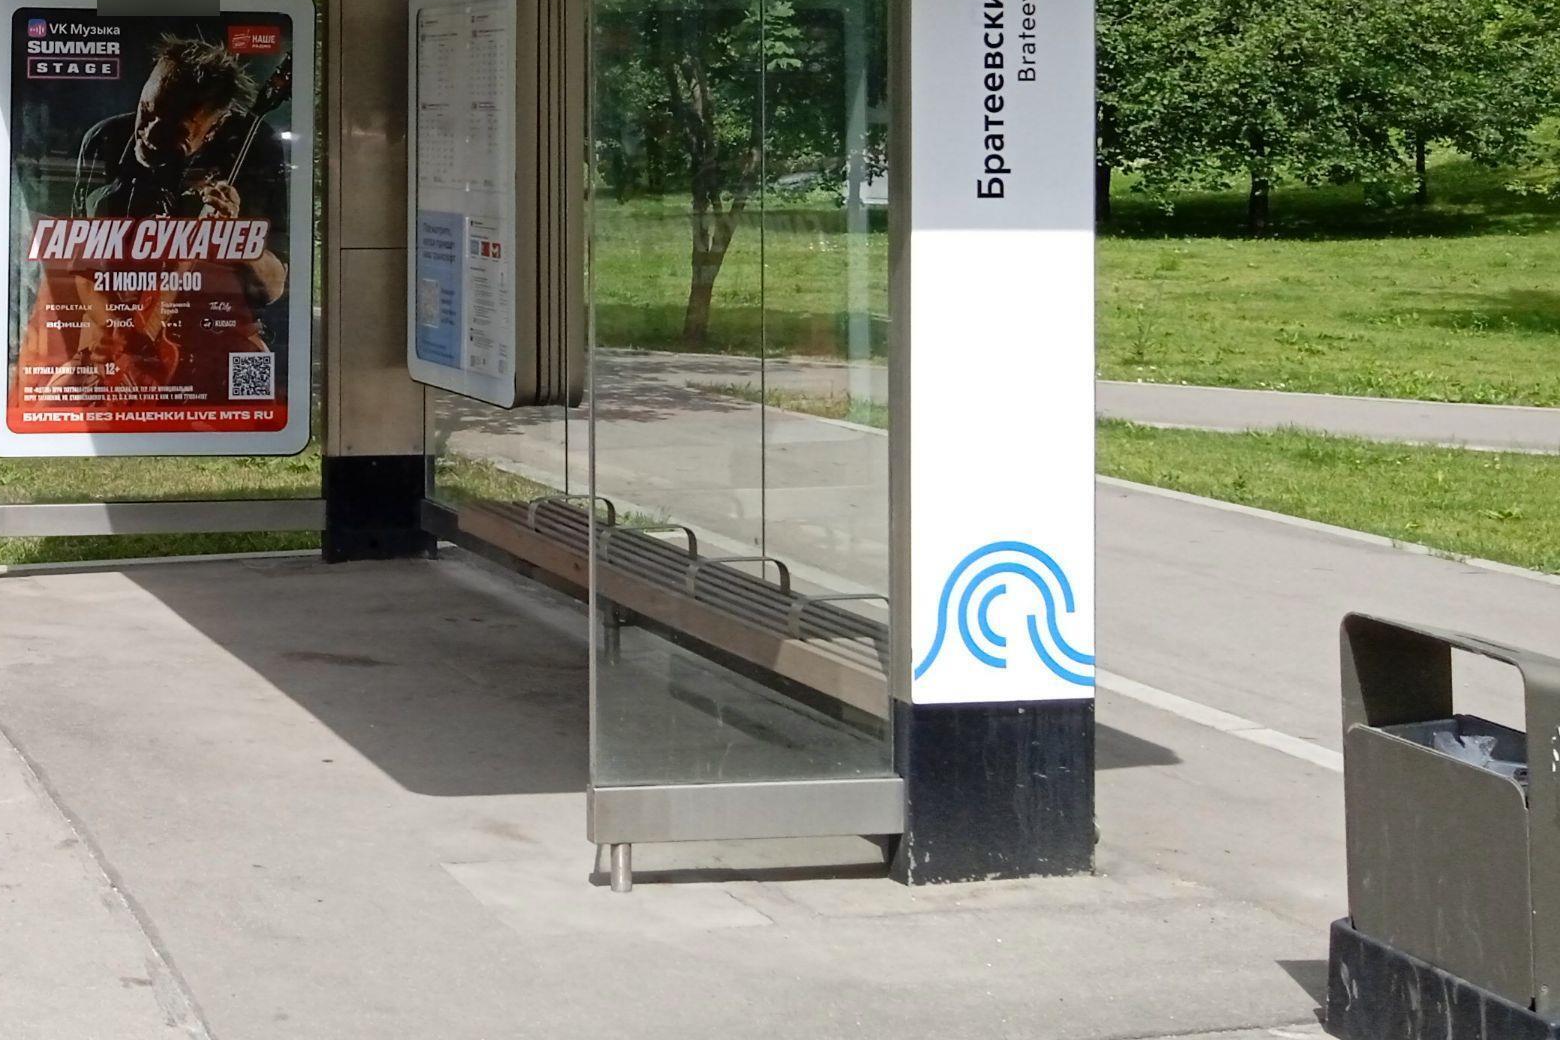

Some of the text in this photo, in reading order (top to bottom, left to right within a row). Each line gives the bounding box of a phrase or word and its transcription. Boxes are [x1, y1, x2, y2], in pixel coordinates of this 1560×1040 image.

[49, 22, 121, 38] VK Музыка
[252, 34, 276, 45] НАШЕ
[27, 40, 121, 55] SUMMER
[36, 62, 112, 74] STAGE
[28, 218, 269, 261] ГАРИК СУКАЧЕВ
[93, 270, 202, 292] 21 ИЮЛЯ 20:00
[45, 303, 93, 312] PEOPLETALK
[105, 362, 121, 375] 12+
[22, 411, 84, 422] БИЛЕТЫ
[85, 411, 114, 422] БЕЗ
[114, 410, 185, 423] НАЦЕНКИ
